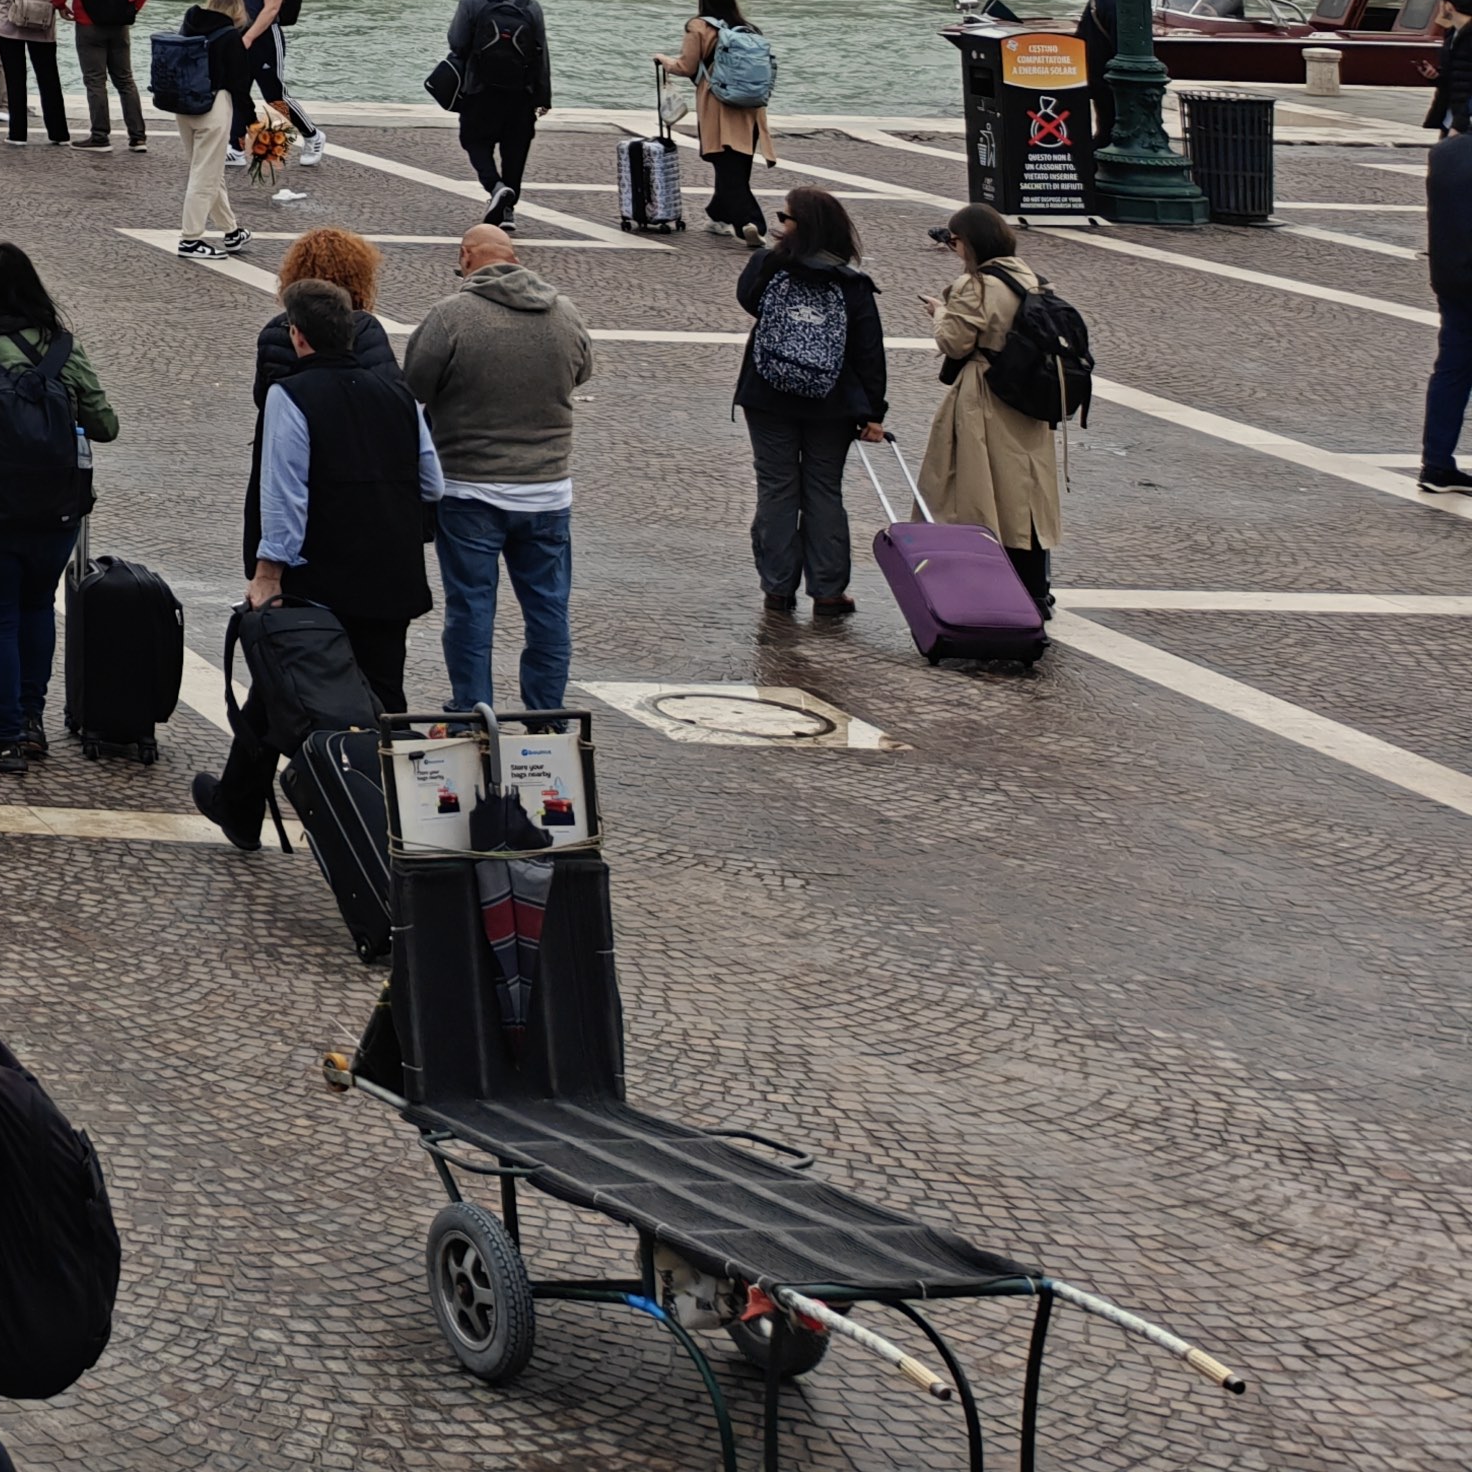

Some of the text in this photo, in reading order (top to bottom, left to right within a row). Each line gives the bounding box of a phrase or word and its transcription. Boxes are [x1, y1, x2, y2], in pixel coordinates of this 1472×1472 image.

[1029, 45, 1058, 53] CESTINO
[1017, 56, 1071, 64] COMPATTATORE
[1019, 67, 1050, 75] ENERGIA
[1050, 67, 1077, 75] SOLARE
[1028, 154, 1052, 162] QUESTO
[1020, 182, 1052, 190] SACCHETTI
